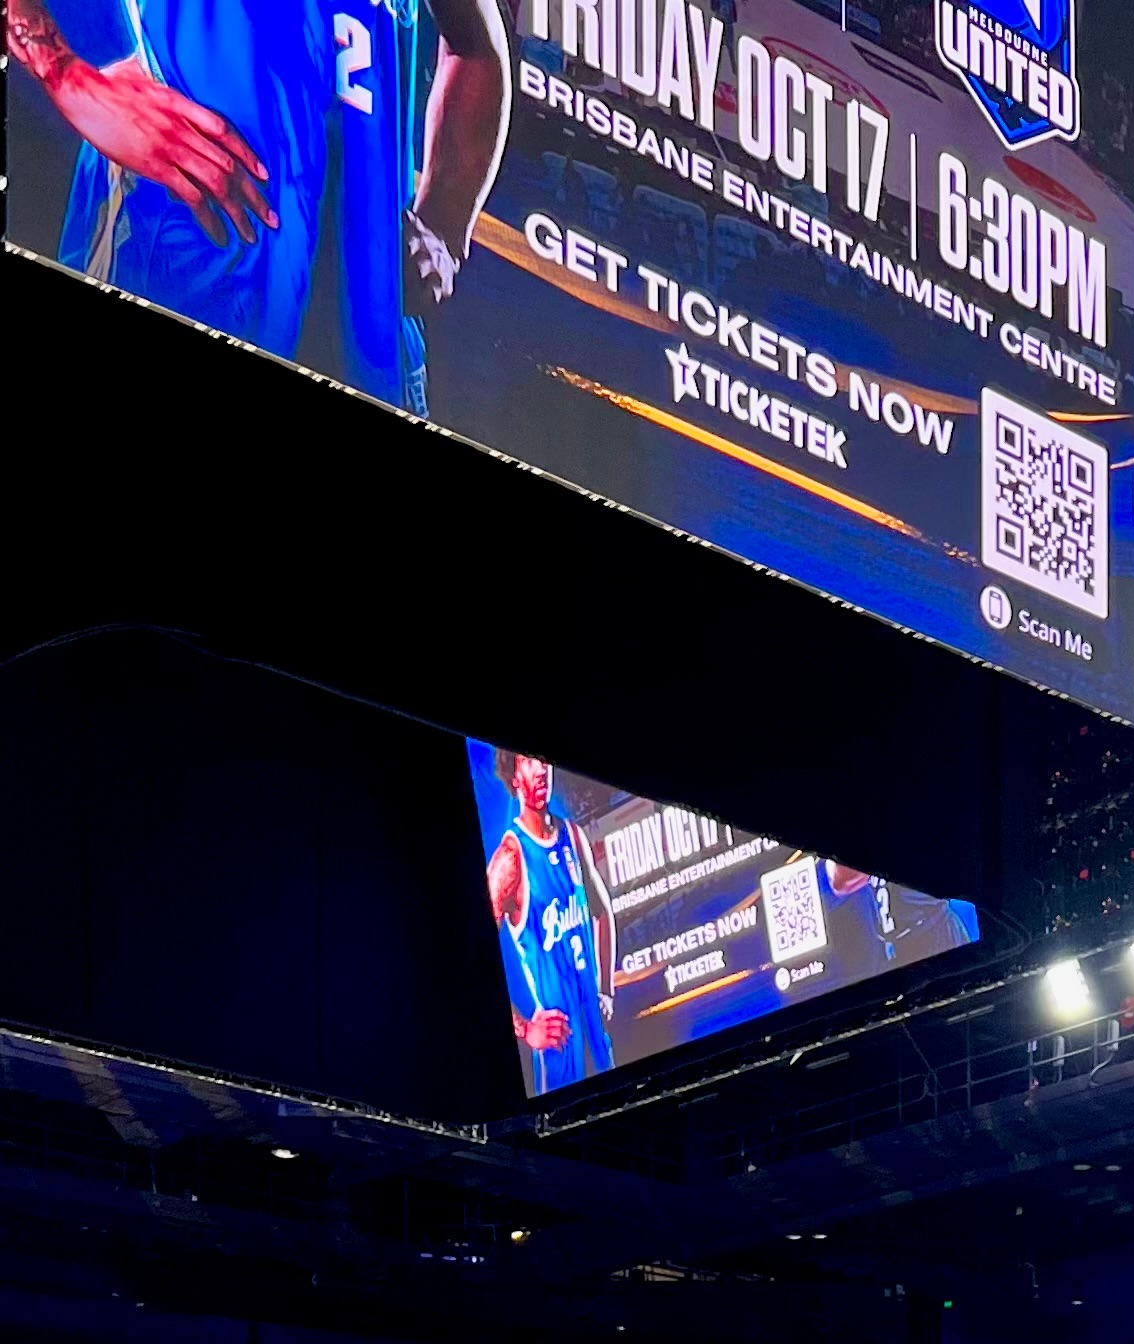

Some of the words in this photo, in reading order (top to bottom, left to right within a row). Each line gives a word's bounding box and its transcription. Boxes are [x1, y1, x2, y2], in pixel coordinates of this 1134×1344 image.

[333, 13, 373, 115] 2
[942, 1, 1074, 131] UNITED
[968, 6, 1049, 67] MELBOURNE
[520, 60, 714, 192] BRISBANE
[722, 169, 994, 338] ENTERTAINMENT
[1000, 322, 1116, 406] CENTRE
[737, 35, 833, 194] OCT
[846, 98, 890, 222] 17
[938, 152, 1107, 348] 6:30PM
[524, 213, 628, 292] GET
[637, 265, 838, 398] TICKETS
[849, 371, 955, 455] NOW
[700, 364, 849, 469] TICKETEK
[1018, 609, 1061, 647] Scan
[1064, 630, 1093, 661] Me
[605, 812, 666, 887] FRIDAY
[611, 877, 669, 914] BRISBANE
[667, 836, 763, 891] ENTERTAINMENT
[622, 946, 653, 974] GET
[652, 921, 718, 963] TICKETS
[717, 905, 758, 939] NOW
